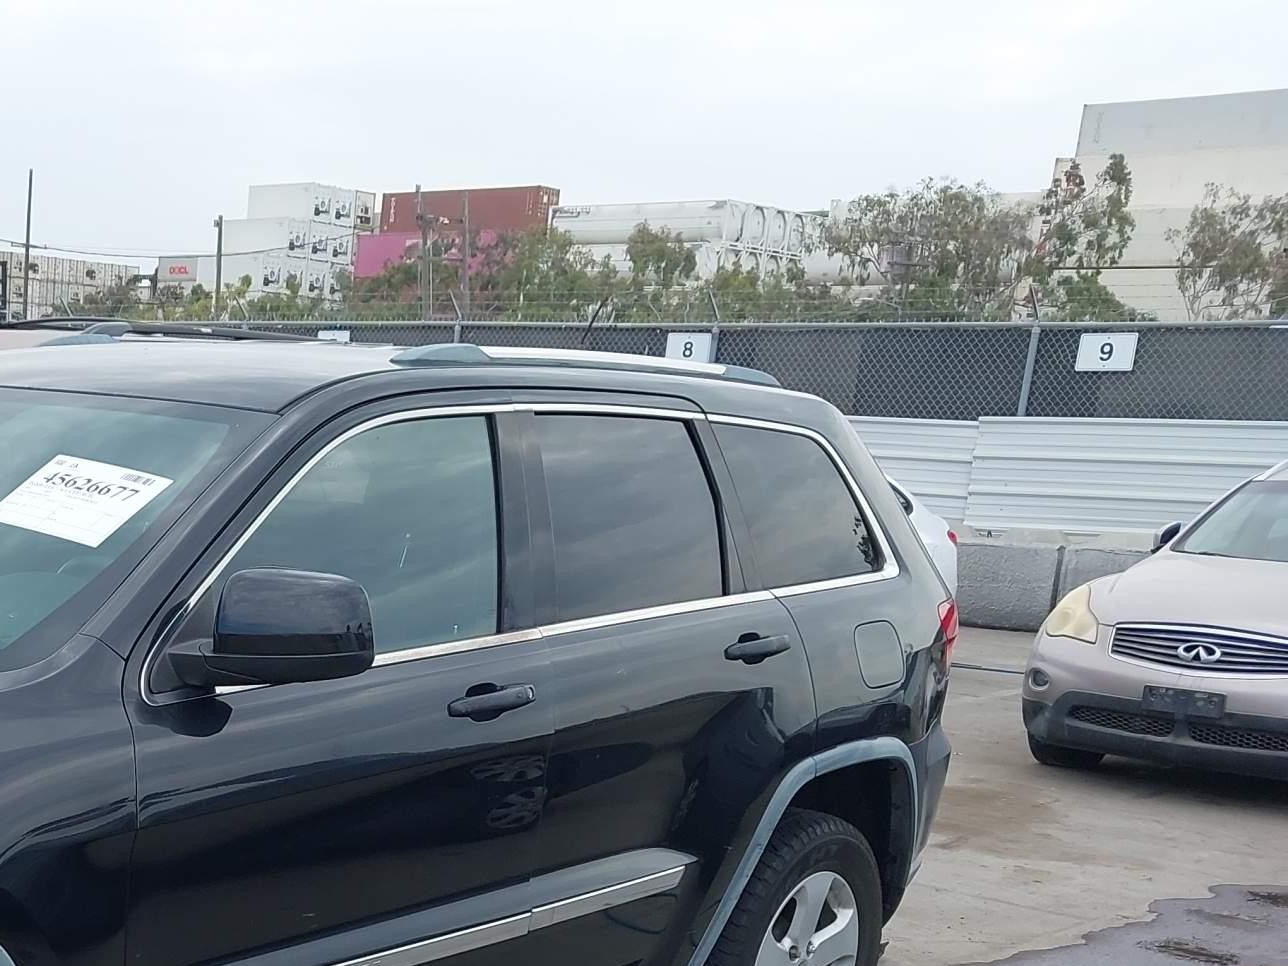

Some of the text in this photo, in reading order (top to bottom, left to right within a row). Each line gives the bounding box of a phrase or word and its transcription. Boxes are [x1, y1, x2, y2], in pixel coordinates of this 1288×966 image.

[682, 341, 694, 358] 8
[1099, 342, 1114, 362] 9
[42, 470, 140, 502] 45626677
